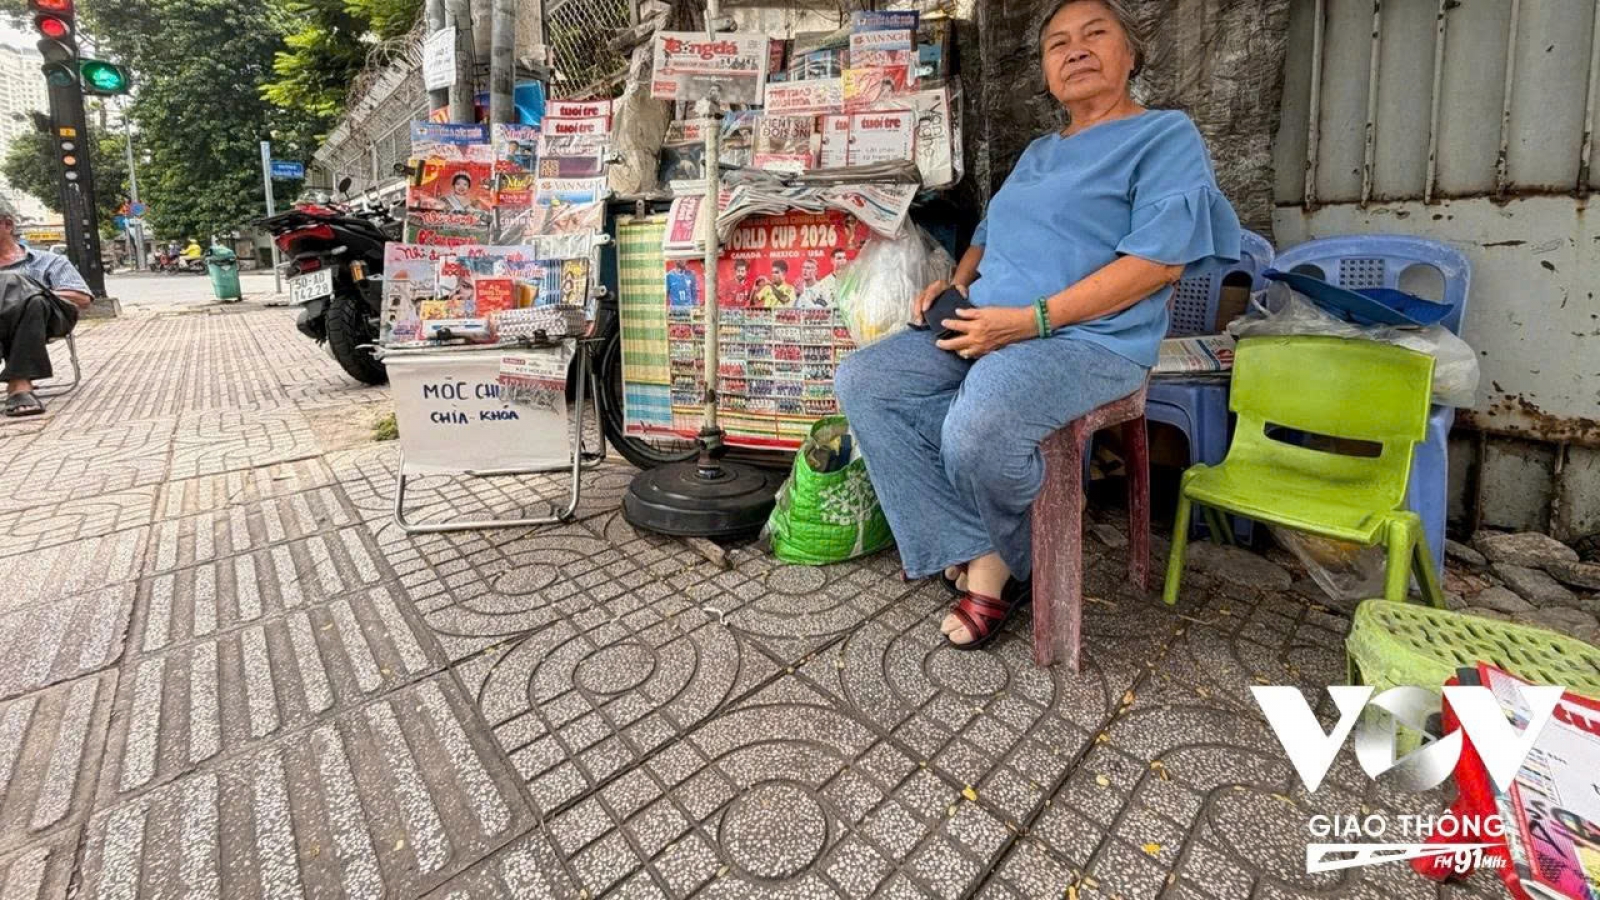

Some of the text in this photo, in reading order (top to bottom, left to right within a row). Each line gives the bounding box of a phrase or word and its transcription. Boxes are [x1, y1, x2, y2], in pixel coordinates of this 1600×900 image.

[770, 225, 797, 249] CUP
[800, 224, 837, 248] 2026
[730, 252, 761, 260] CANADA
[808, 249, 825, 257] USA
